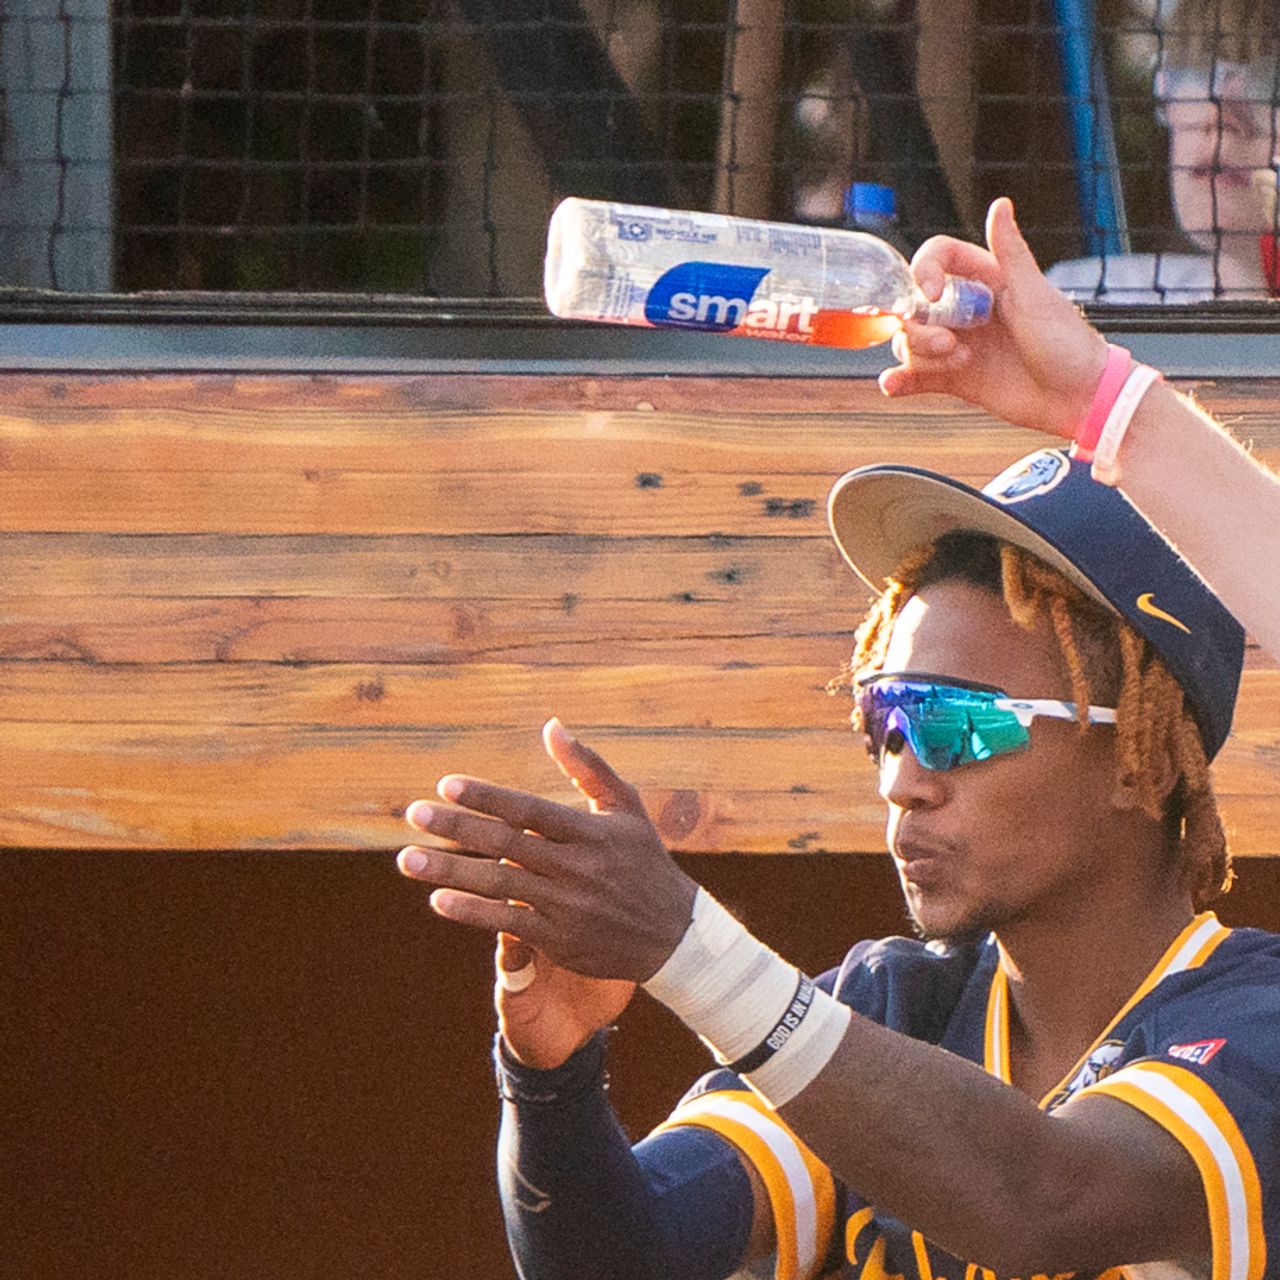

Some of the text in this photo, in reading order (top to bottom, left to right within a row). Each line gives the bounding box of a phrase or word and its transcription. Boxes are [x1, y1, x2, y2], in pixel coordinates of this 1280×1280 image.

[668, 291, 818, 333] smart
[790, 999, 808, 1019] IN
[783, 1012, 800, 1029] IS
[766, 1025, 792, 1050] GOD
